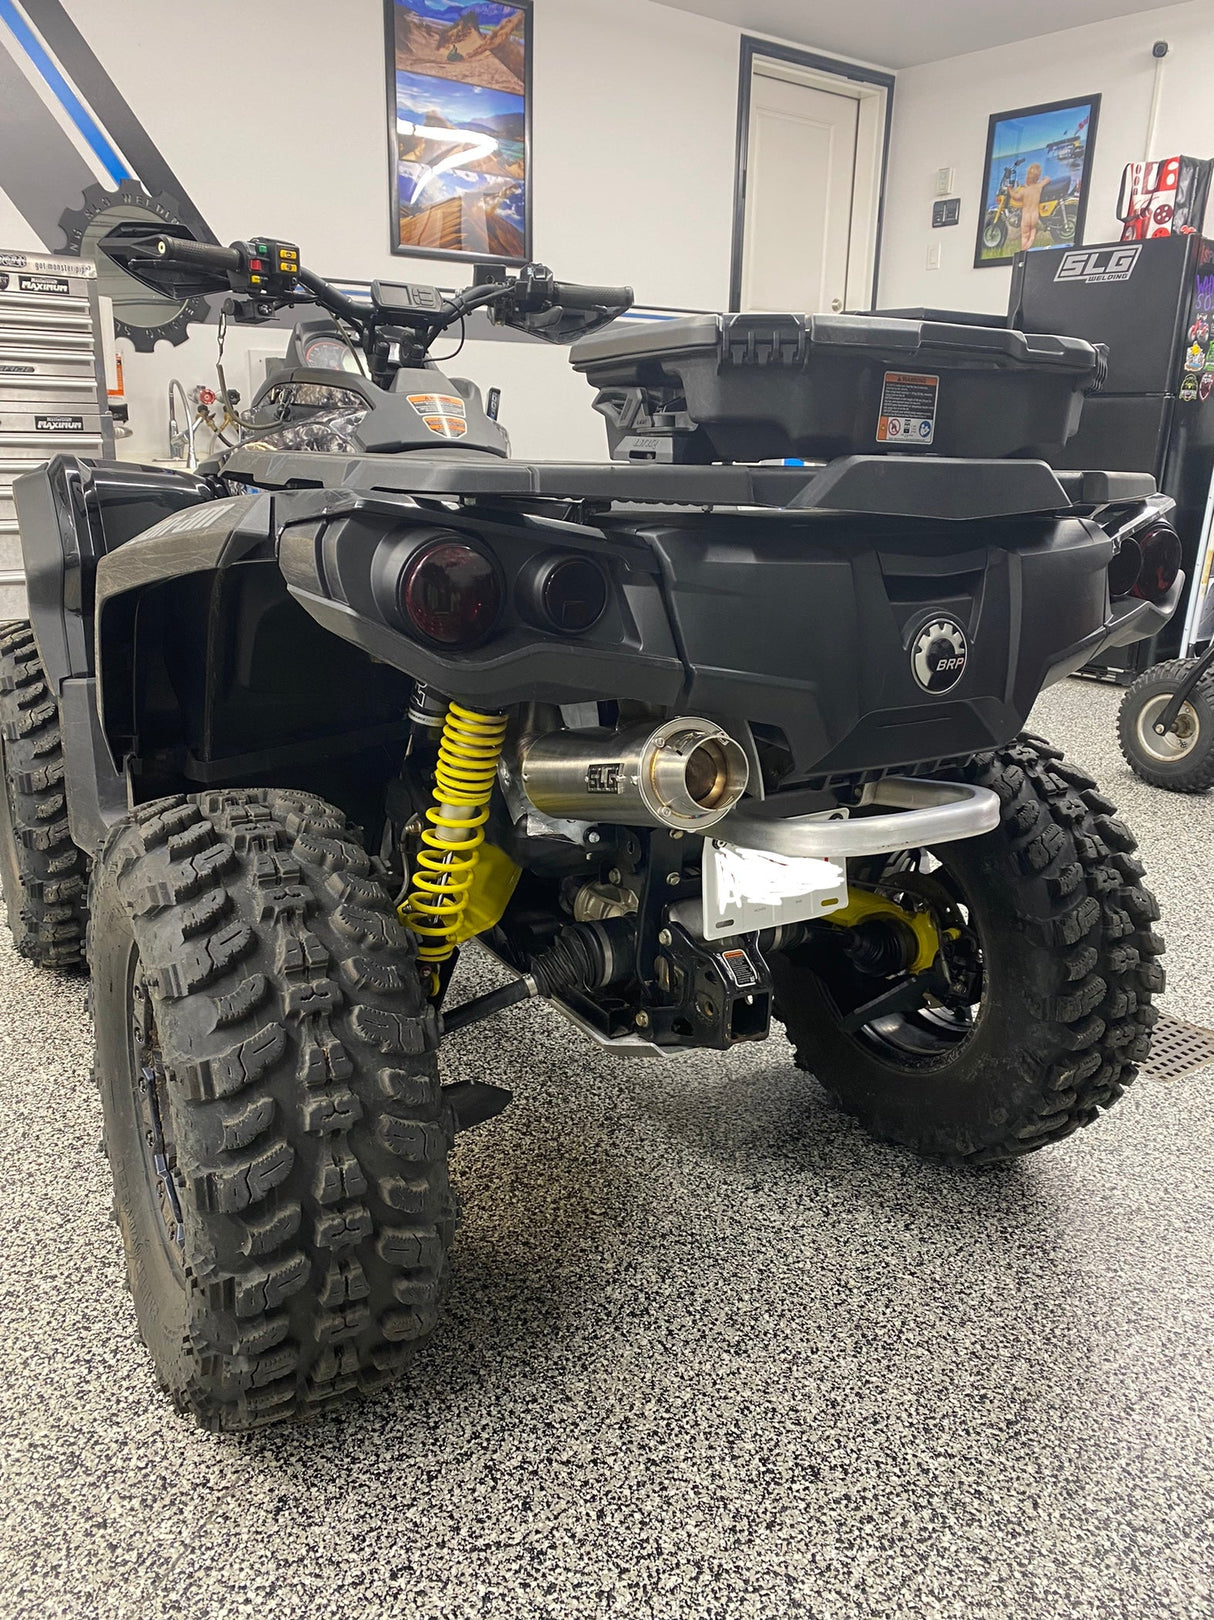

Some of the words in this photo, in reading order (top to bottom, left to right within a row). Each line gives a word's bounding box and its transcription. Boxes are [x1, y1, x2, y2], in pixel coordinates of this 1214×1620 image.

[35, 262, 46, 271] got
[48, 263, 73, 272] monster
[1060, 249, 1137, 277] SLG
[1088, 273, 1129, 282] WELDING
[21, 281, 68, 292] MAXIMUM
[37, 421, 82, 430] MAXIMUM
[936, 657, 965, 671] BRP
